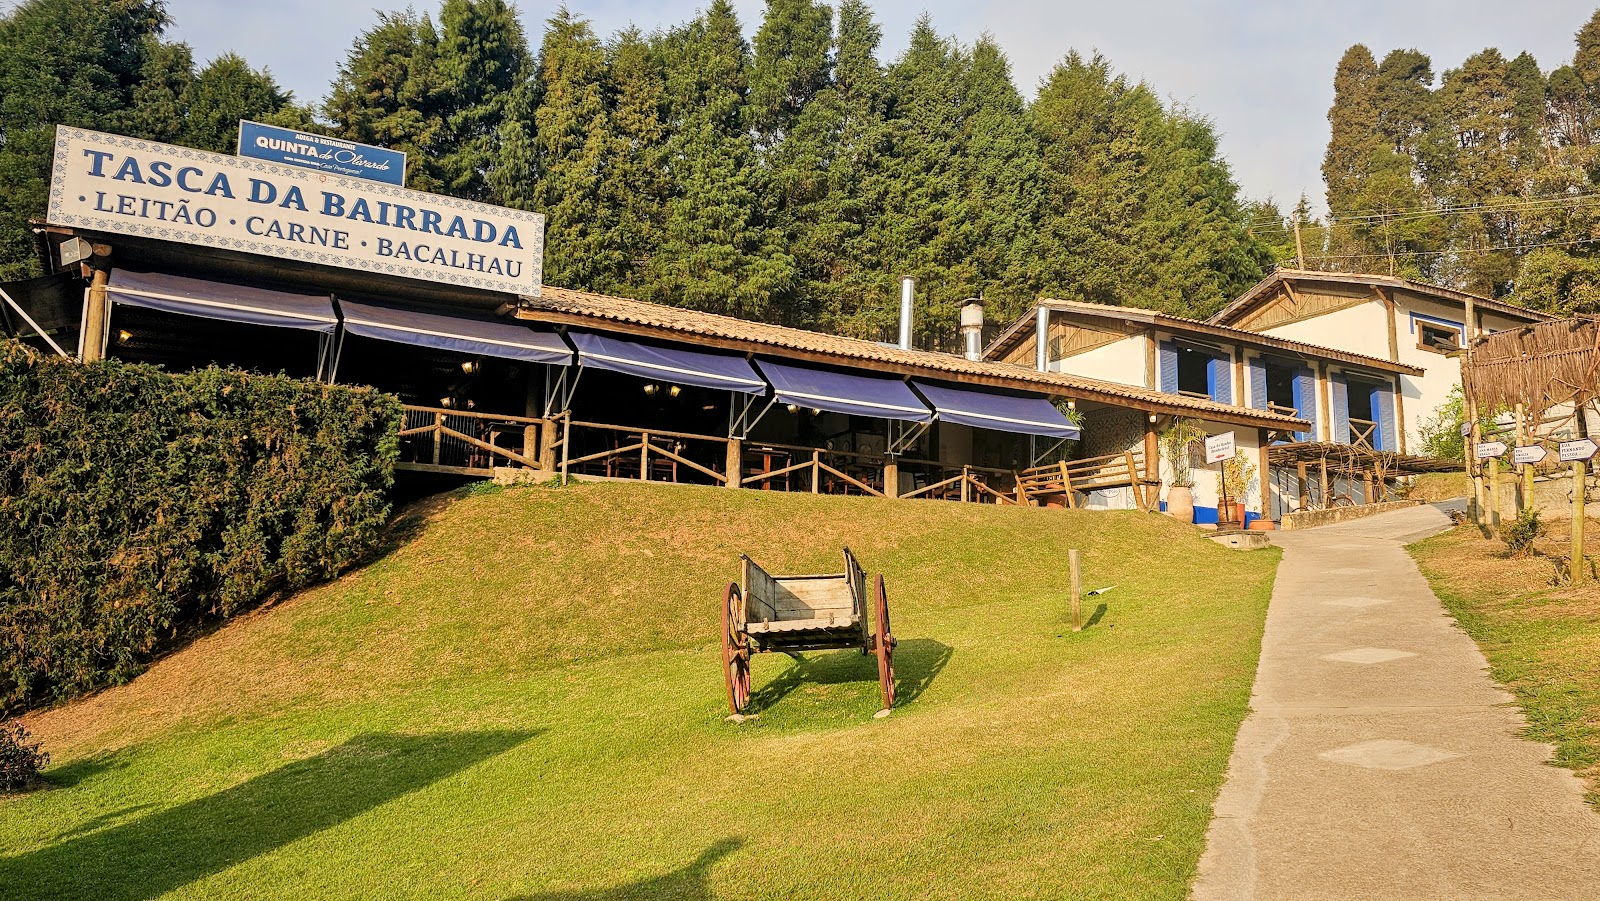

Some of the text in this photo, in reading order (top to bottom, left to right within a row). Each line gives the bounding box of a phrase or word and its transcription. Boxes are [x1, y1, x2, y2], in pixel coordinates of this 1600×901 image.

[256, 136, 391, 171] QUINTA do Olivardo
[295, 133, 315, 143] ADEGA
[320, 138, 357, 151] RESTAURANTE
[83, 149, 525, 251] TASCA DA BAIRRADA
[94, 190, 524, 279] LEITÃO CARNE BACALHAU
